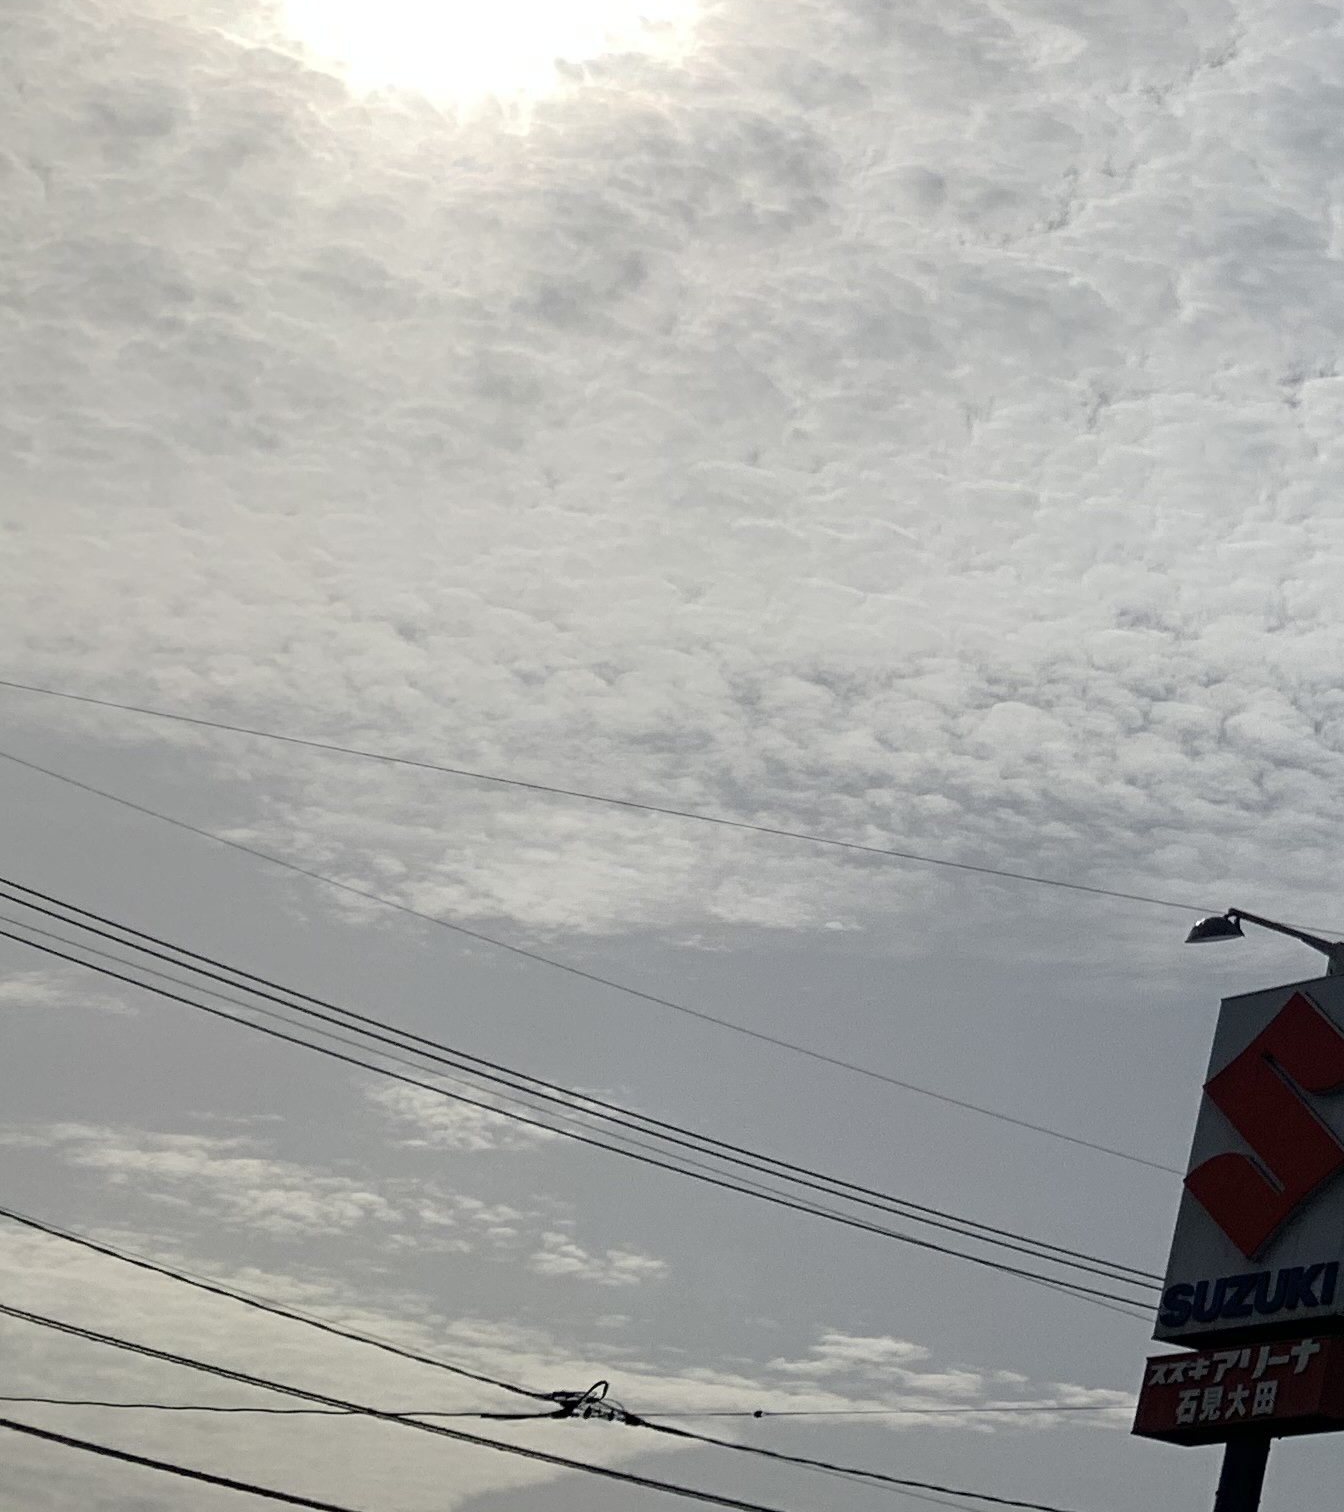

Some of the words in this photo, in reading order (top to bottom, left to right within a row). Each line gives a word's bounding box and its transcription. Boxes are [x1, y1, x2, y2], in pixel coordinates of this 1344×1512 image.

[1159, 1262, 1340, 1328] SUZUKI
[1148, 1338, 1321, 1386] スズキアリーナ
[1175, 1380, 1278, 1425] 石見大田
